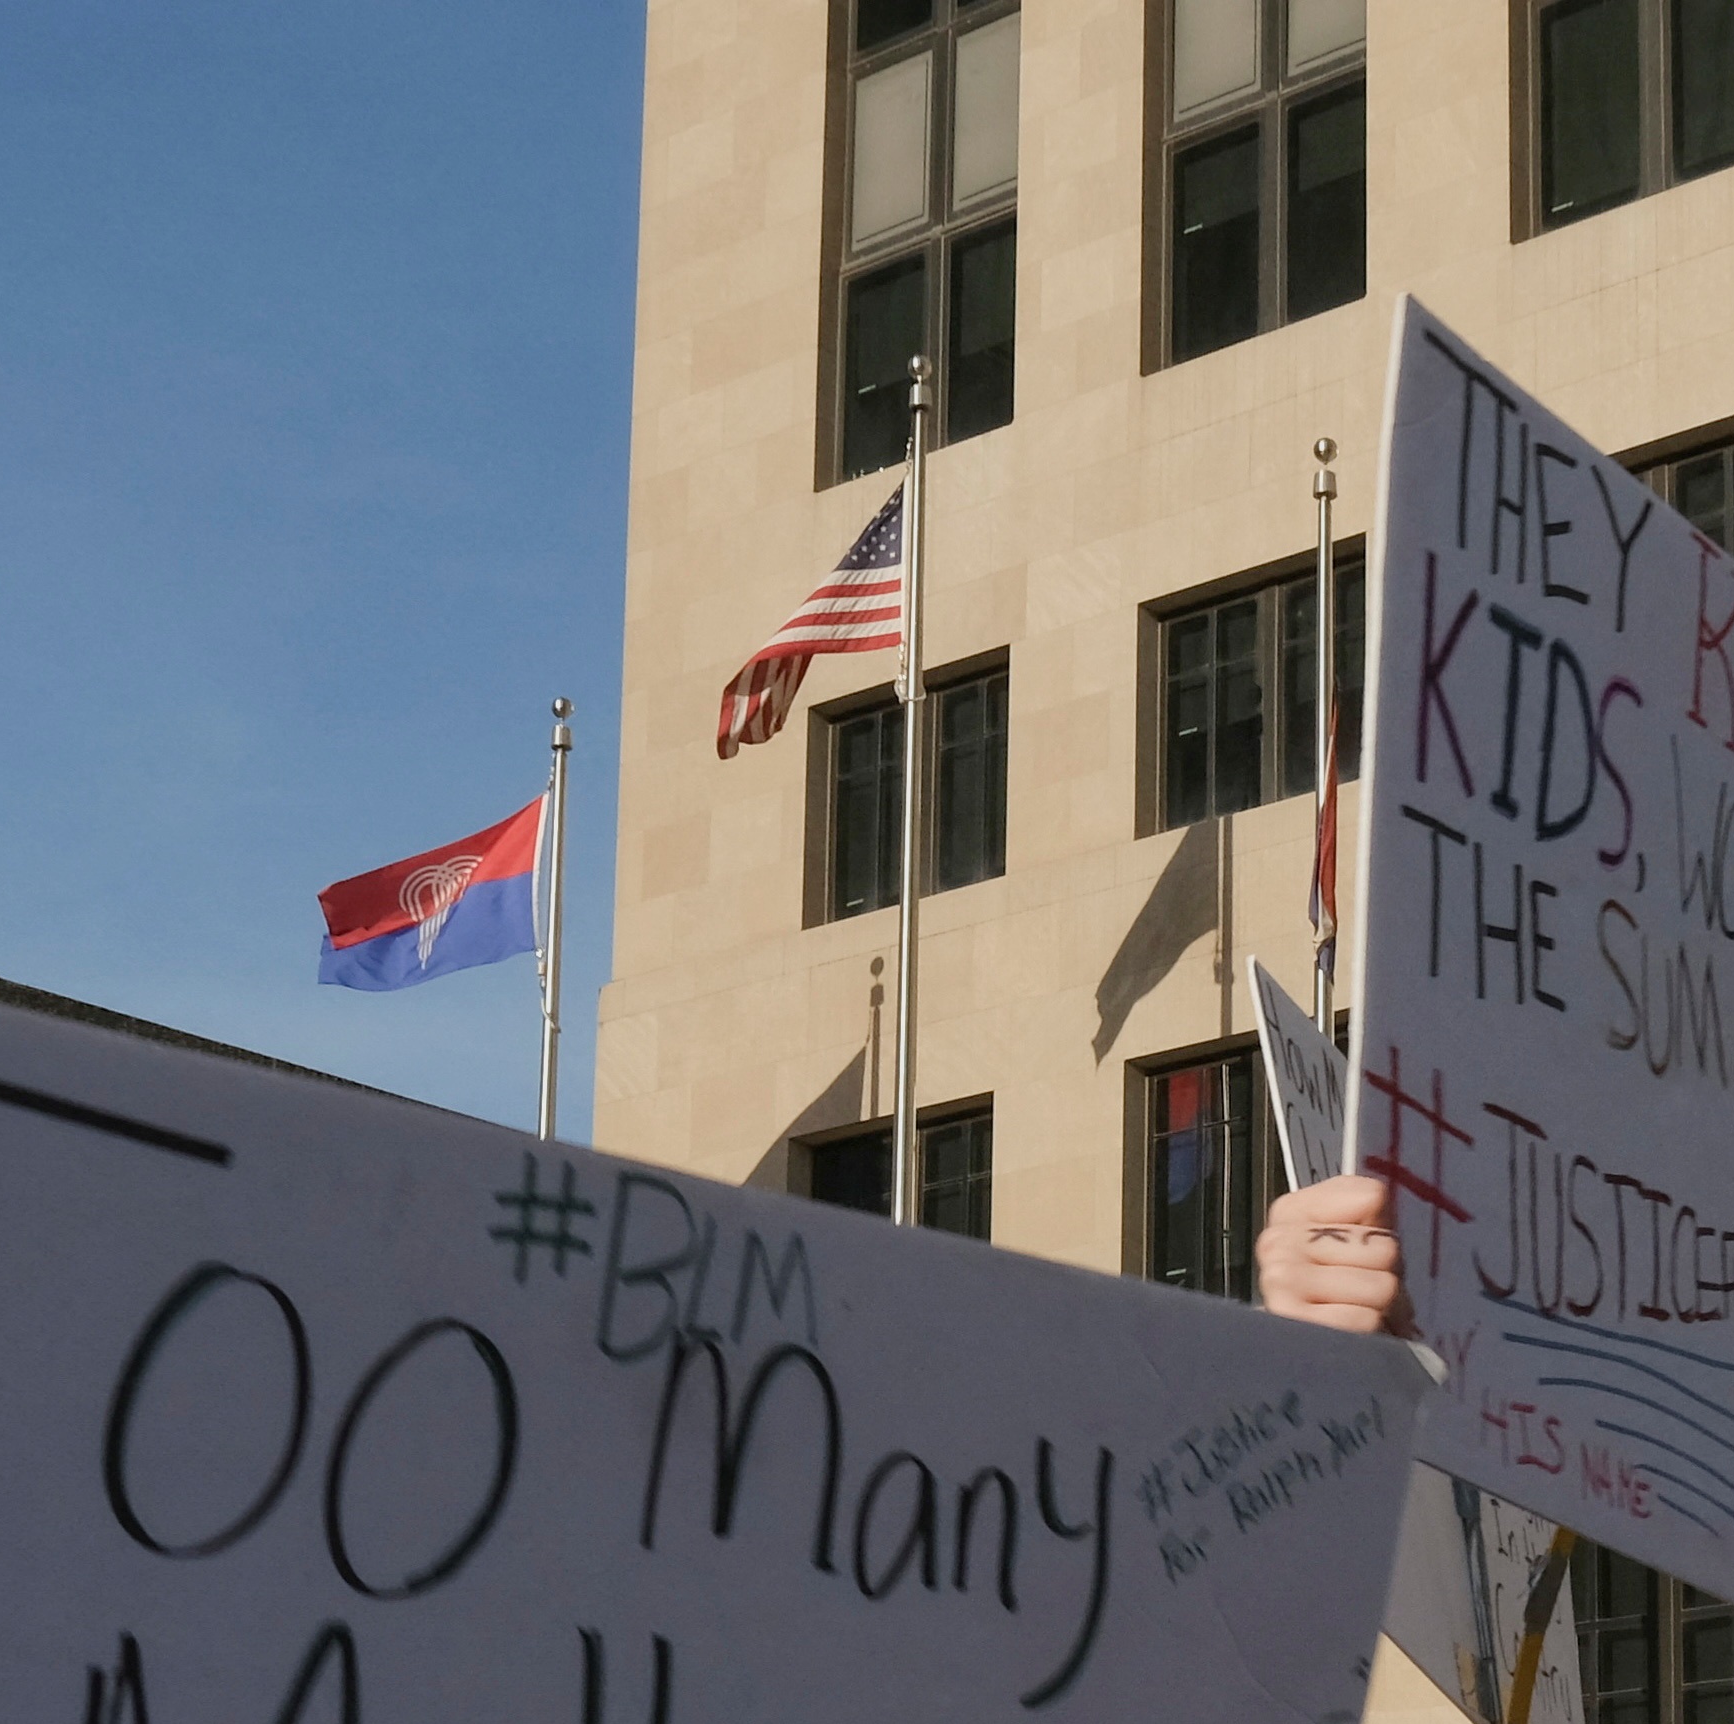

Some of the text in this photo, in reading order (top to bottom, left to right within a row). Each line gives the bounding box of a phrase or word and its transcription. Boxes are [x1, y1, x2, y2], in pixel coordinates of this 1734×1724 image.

[1423, 328, 1653, 633] THEY
[1417, 553, 1647, 892] KIDS,
[1401, 805, 1567, 1012] THE
[489, 1152, 821, 1362] #BLM
[1480, 1388, 1653, 1520] HIS NAME
